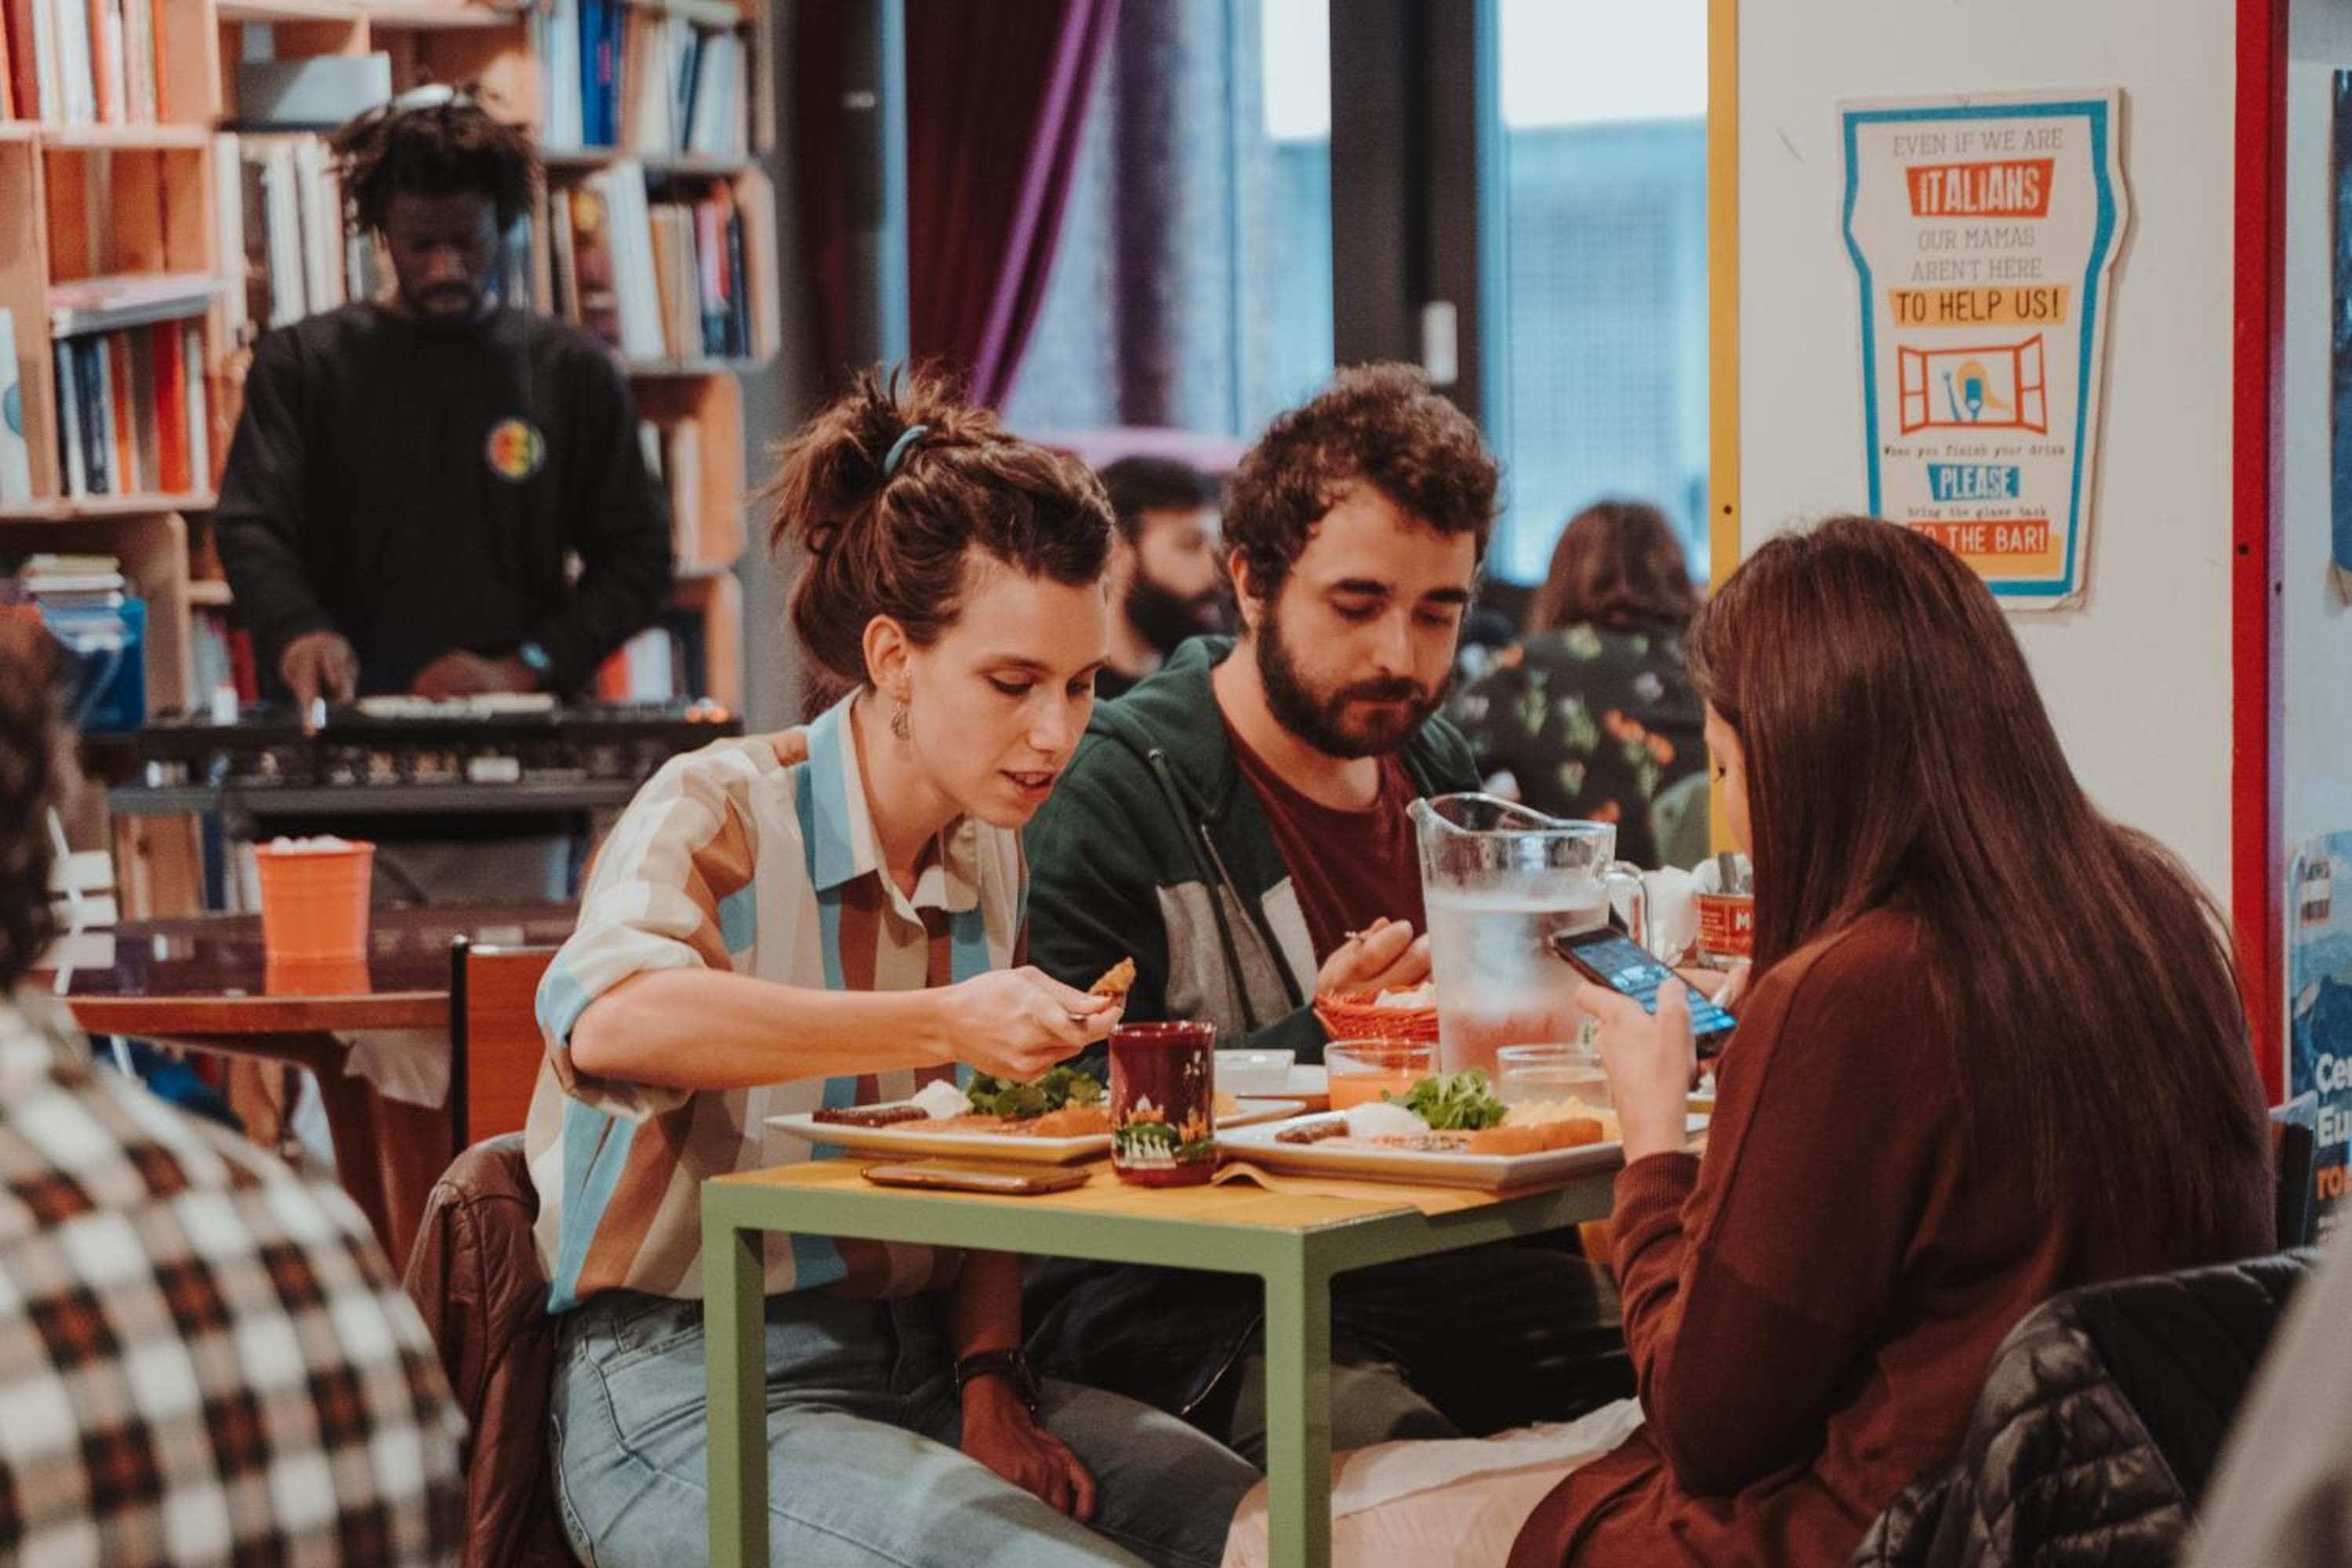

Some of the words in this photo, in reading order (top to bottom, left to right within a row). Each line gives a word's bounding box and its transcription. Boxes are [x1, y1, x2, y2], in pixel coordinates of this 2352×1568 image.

[1893, 133, 1946, 157] EVEN
[1955, 132, 1974, 154] IF
[1981, 129, 2016, 151] WE
[2024, 127, 2063, 151] ARE
[1920, 165, 2040, 213] ITALIANS
[1918, 229, 1957, 251] OUR
[1965, 227, 2035, 251] MAMAS
[1988, 256, 2043, 280] HERE
[1896, 291, 1926, 321] TO
[1940, 289, 2002, 321] HELP
[2015, 288, 2059, 319] US!
[1940, 466, 2013, 499] PLEASE
[1947, 525, 1987, 552] THE
[1994, 525, 2045, 552] BAR!
